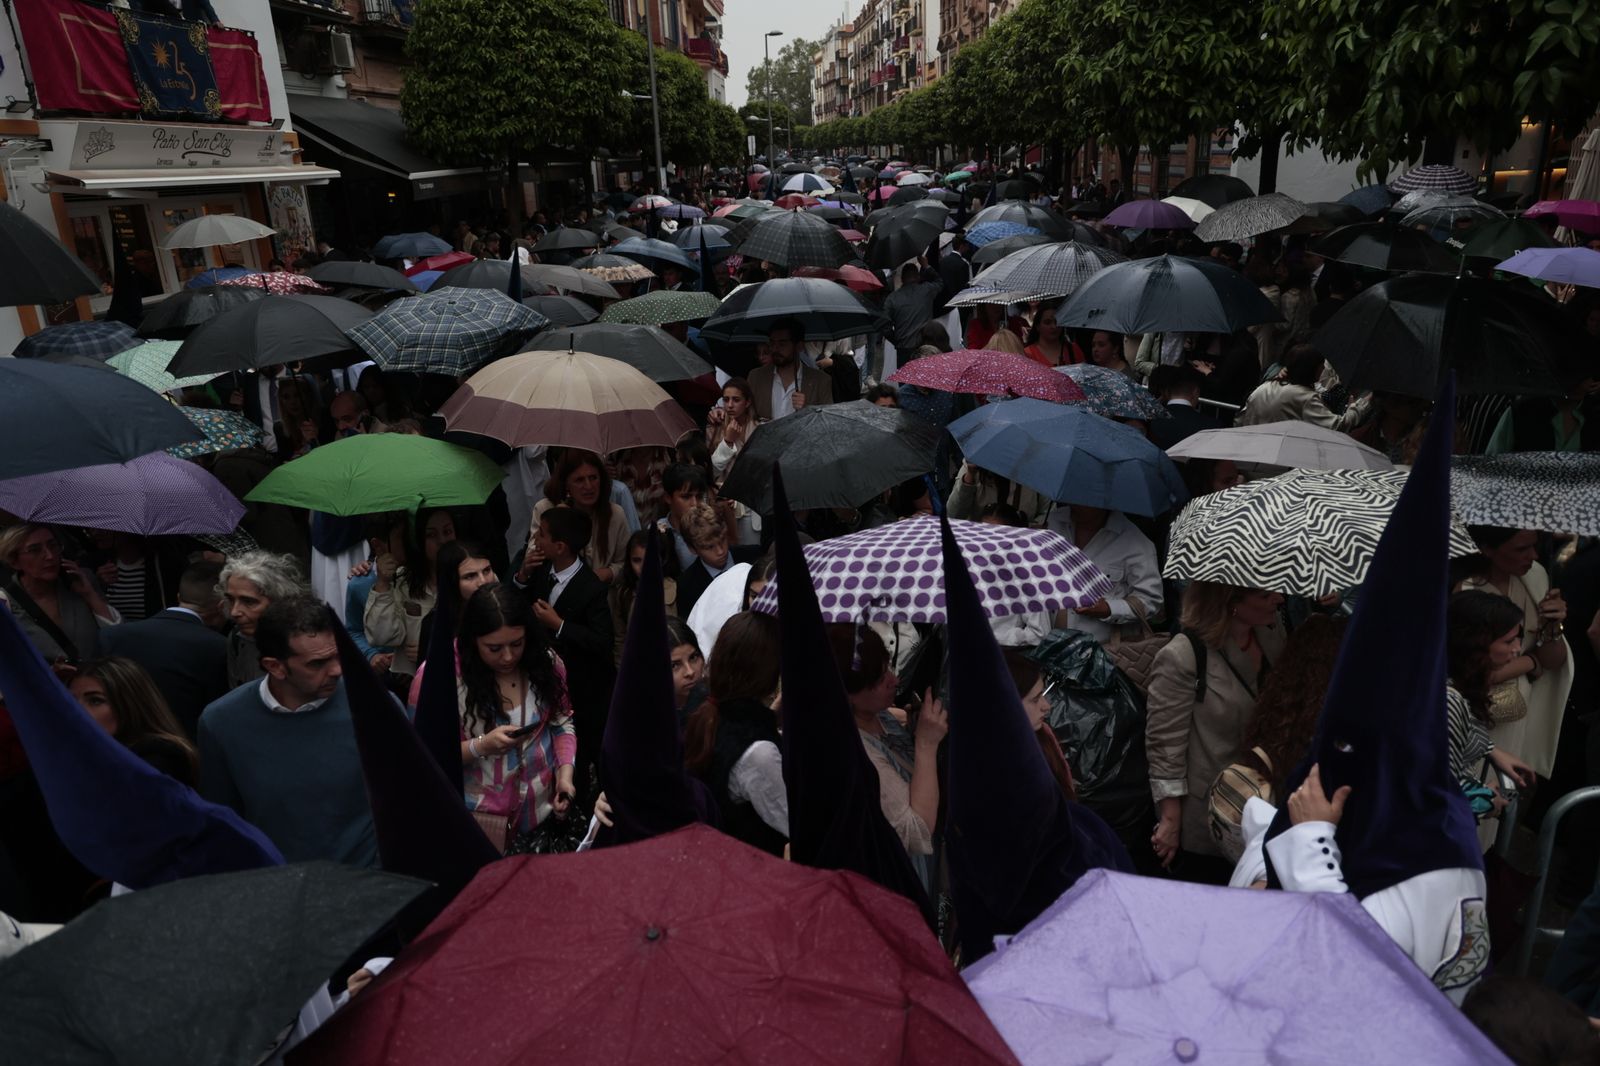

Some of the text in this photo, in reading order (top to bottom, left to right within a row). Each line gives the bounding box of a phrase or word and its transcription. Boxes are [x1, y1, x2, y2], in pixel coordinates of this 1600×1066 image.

[152, 128, 233, 156] Patio San Eloy
[281, 187, 303, 208] PATIO
